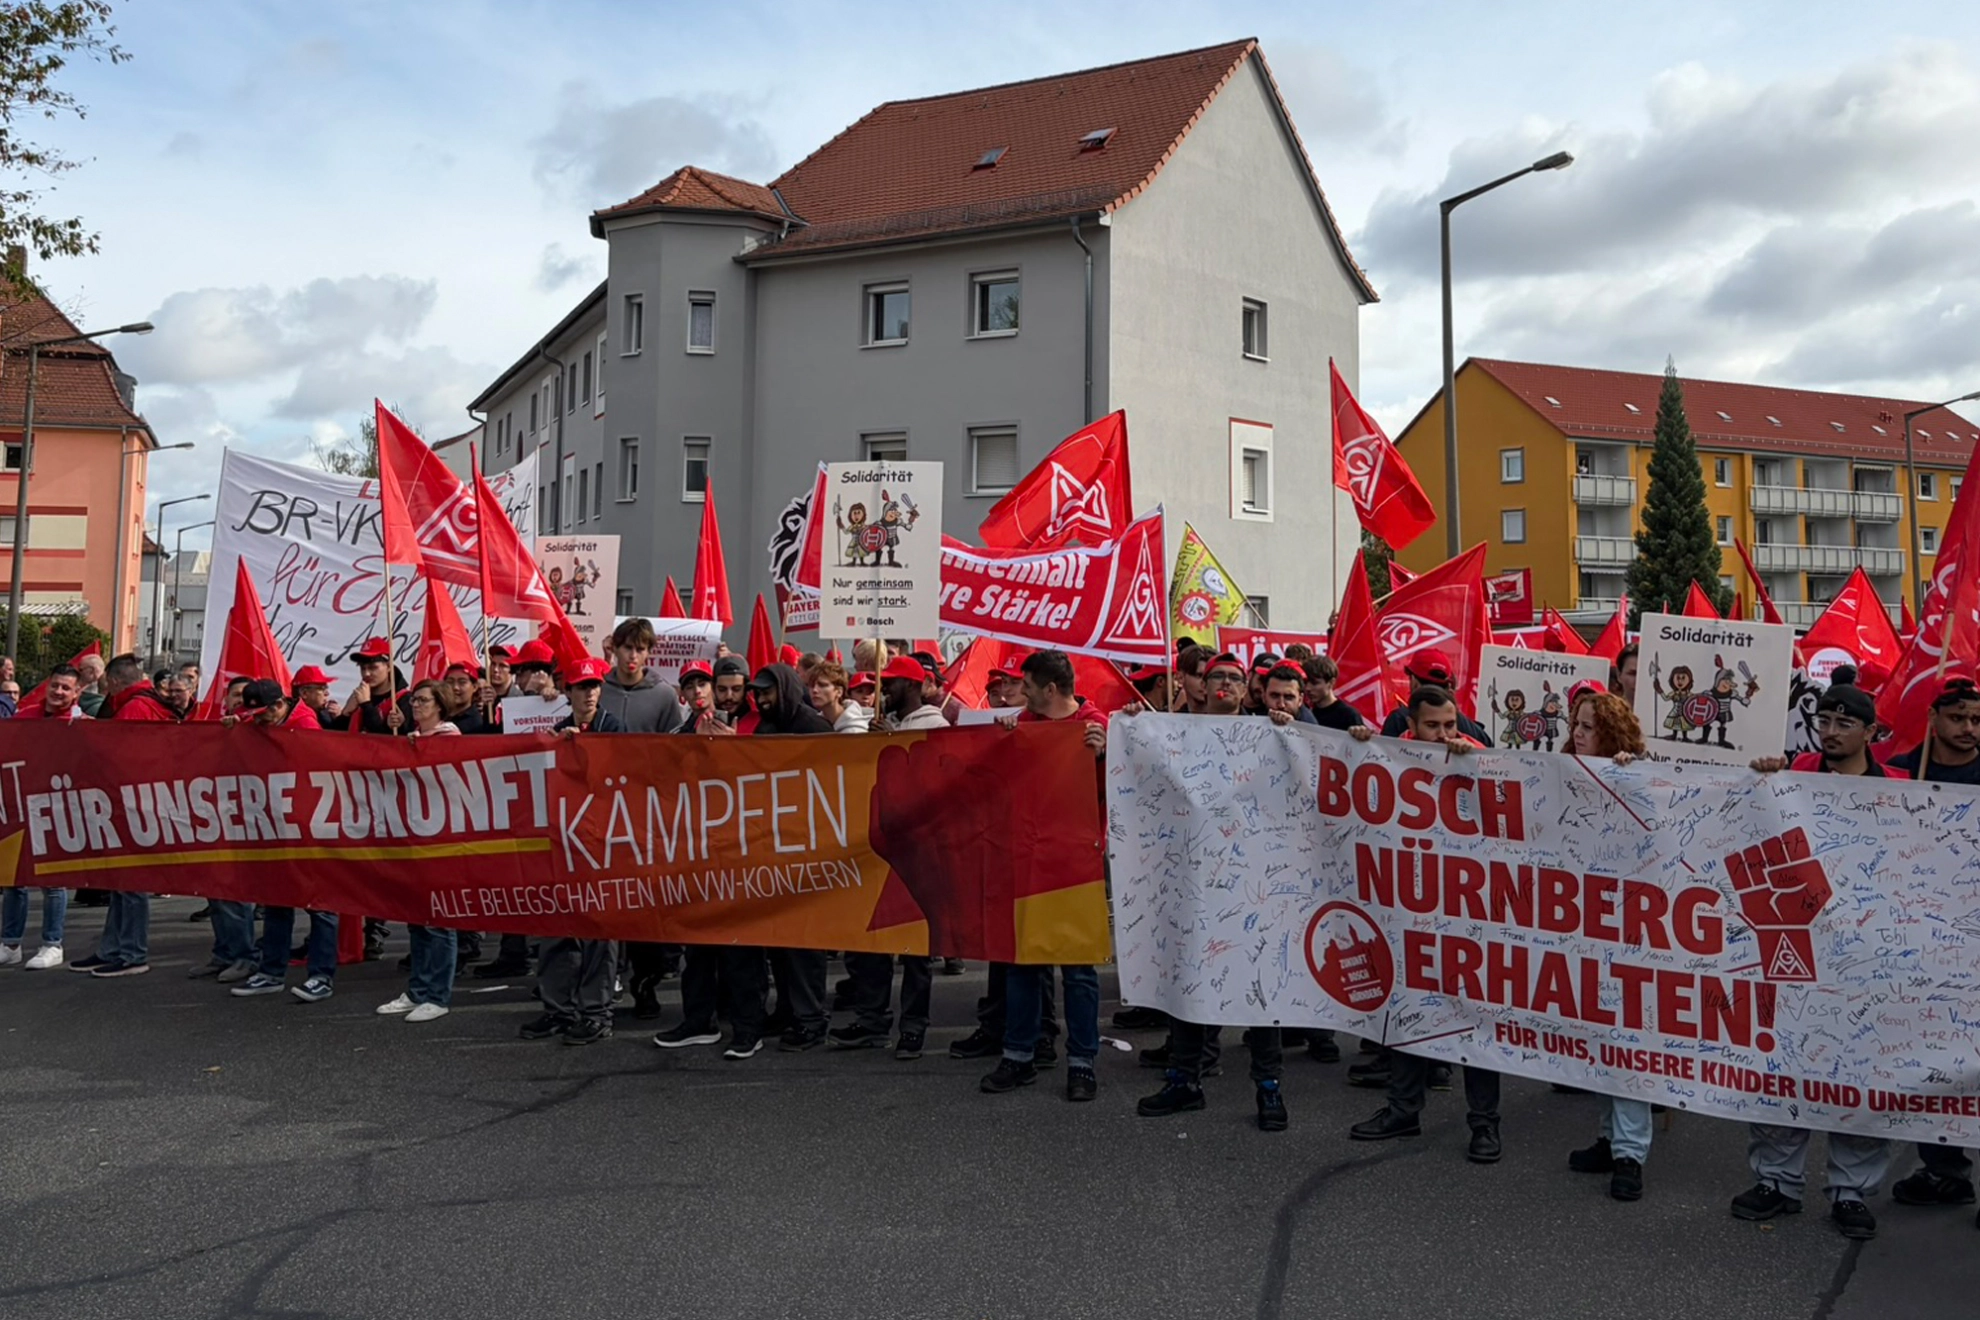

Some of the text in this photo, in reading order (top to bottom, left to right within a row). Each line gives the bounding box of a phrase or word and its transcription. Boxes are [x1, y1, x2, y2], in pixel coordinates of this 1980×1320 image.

[841, 470, 913, 483] Solidarität
[545, 542, 597, 552] Solidarität
[833, 577, 913, 591] Nur gemeinsam
[833, 595, 911, 607] sind wir stark.
[972, 583, 1082, 631] Stärke!
[866, 616, 894, 626] Bosch
[653, 641, 696, 651] CHÄFTIGTE
[1659, 626, 1754, 648] Solidarität
[1497, 655, 1577, 676] Solidarität
[513, 716, 553, 727] VORSTÄNDE
[27, 750, 556, 856] FÜR UNSERE ZUKUNFT
[1317, 754, 1525, 842] BOSCH
[559, 765, 848, 873] KÄMPFEN
[1812, 820, 1878, 846] Sandro
[430, 857, 863, 918] ALLE BELEGSCHAFTEN IM VW-KONZERN
[1355, 836, 1724, 957] NÜRNBERG
[1348, 986, 1384, 1003] NÜRNBERG
[1403, 928, 1777, 1053] ERHALTEN!
[1495, 1020, 1538, 1050] FÜR
[1542, 1031, 1596, 1066] UNS,
[1600, 1045, 1695, 1080] UNSERE
[1701, 1060, 1797, 1099] KINDER
[1803, 1079, 1862, 1109] UND
